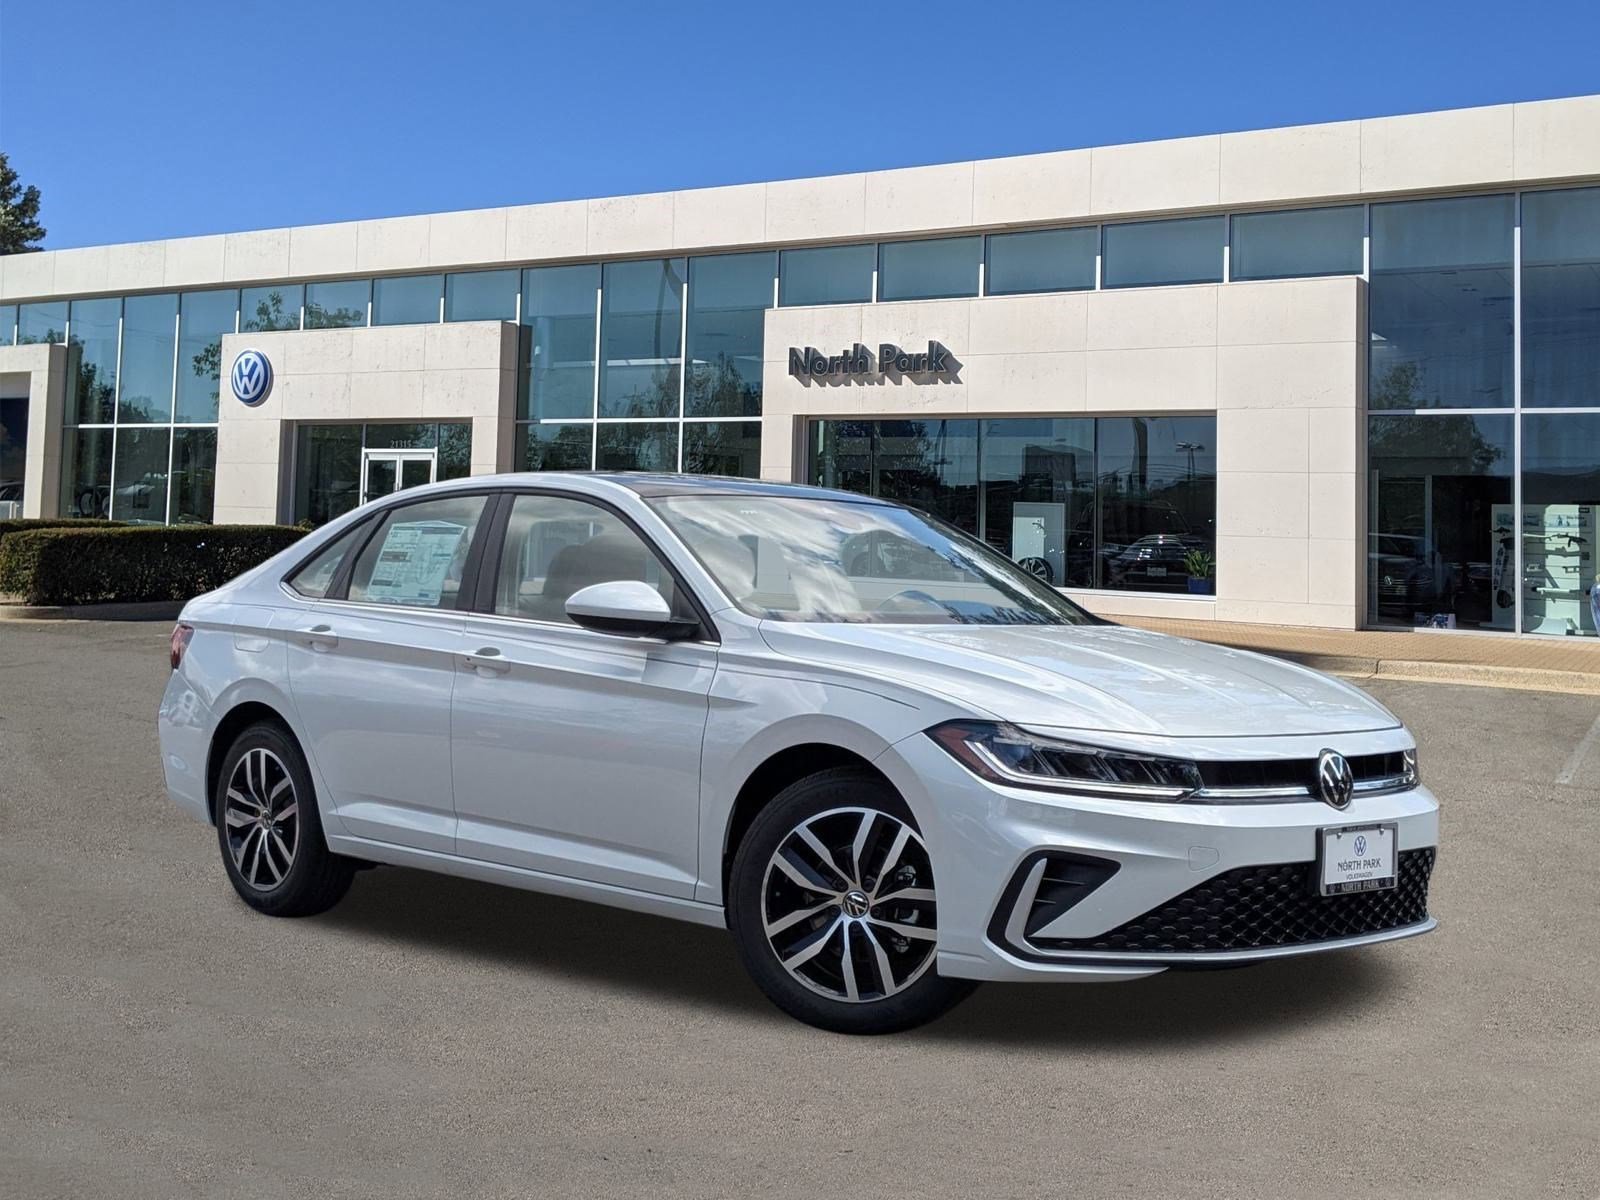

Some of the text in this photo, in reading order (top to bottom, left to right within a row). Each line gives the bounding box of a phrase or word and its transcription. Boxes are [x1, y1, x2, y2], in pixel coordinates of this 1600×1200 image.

[788, 340, 947, 376] North Park
[1363, 858, 1382, 870] PARK
